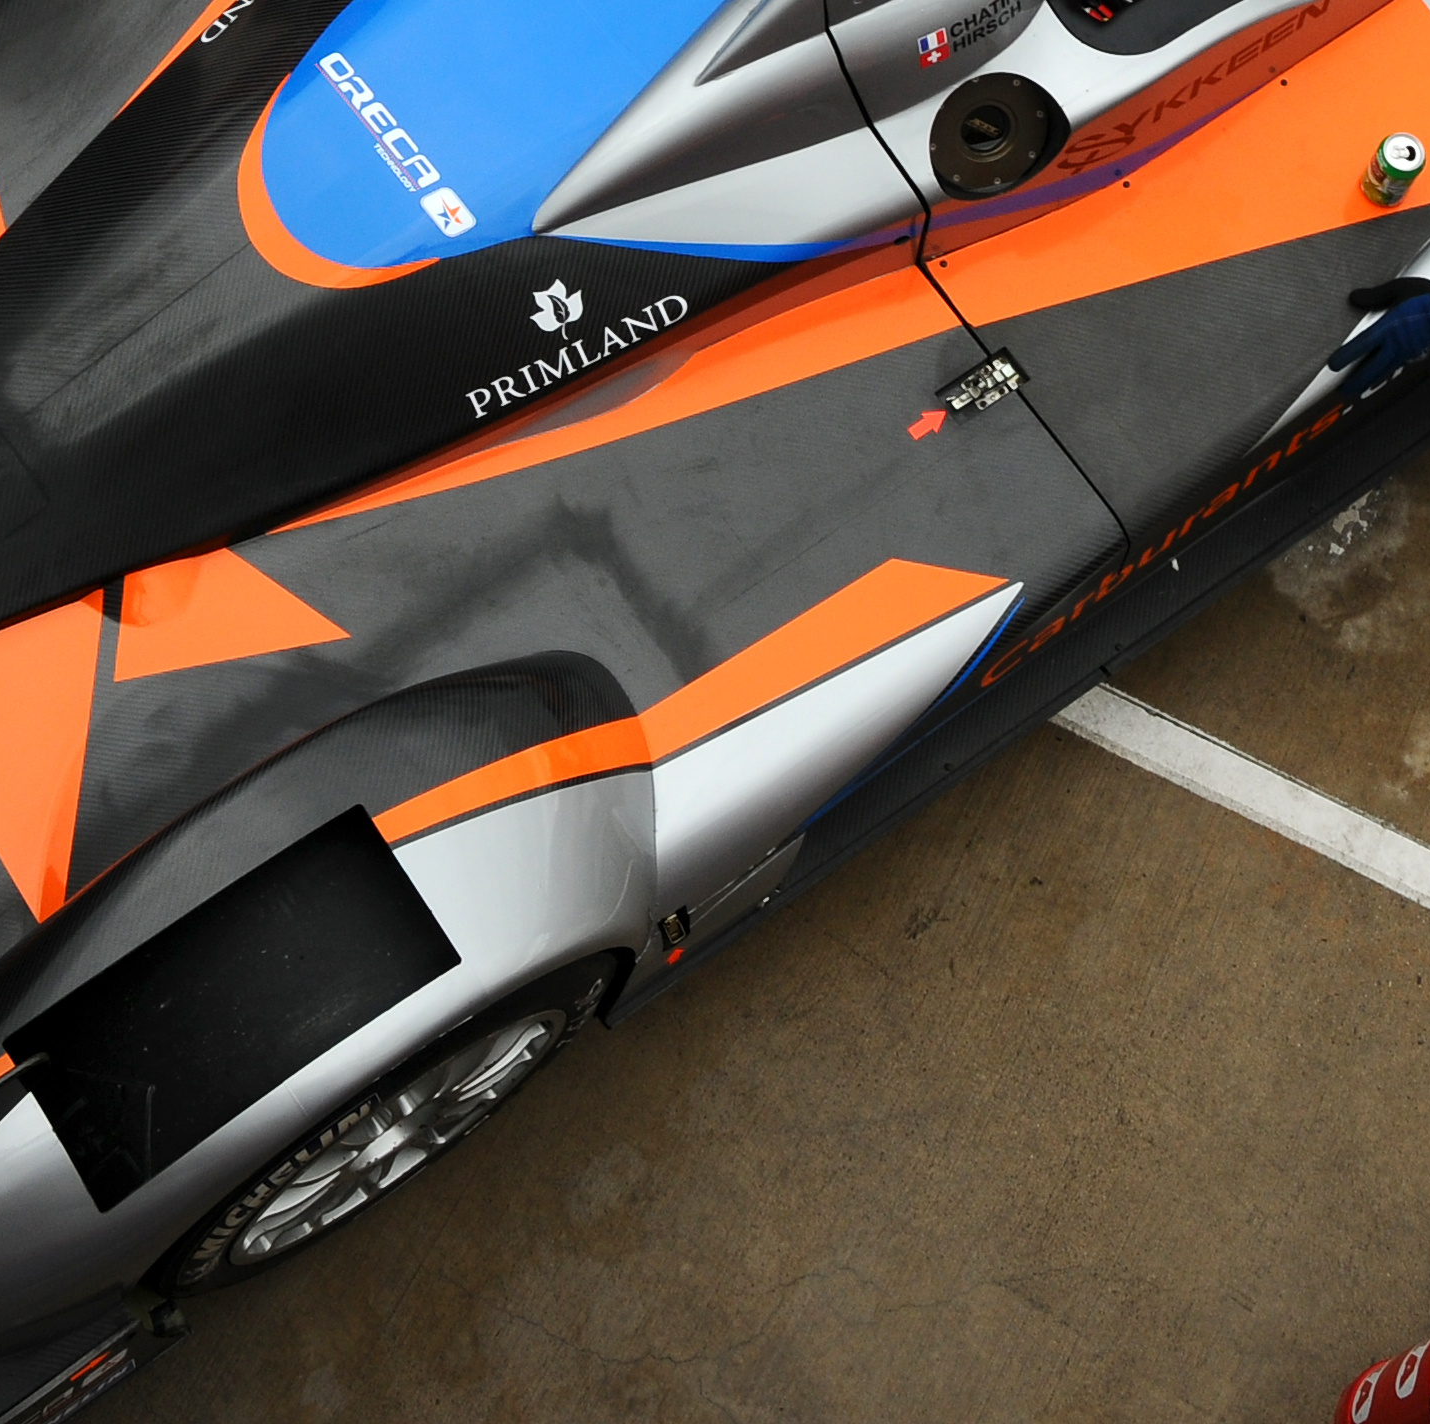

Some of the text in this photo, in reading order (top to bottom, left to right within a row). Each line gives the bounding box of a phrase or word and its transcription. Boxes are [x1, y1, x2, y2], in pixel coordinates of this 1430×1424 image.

[953, 0, 1021, 53] HIRSCH
[319, 52, 441, 189] ORECA
[373, 143, 417, 193] TECHNOLOGY
[465, 294, 690, 420] PRIMLAND
[193, 1104, 372, 1261] MICHELIN
